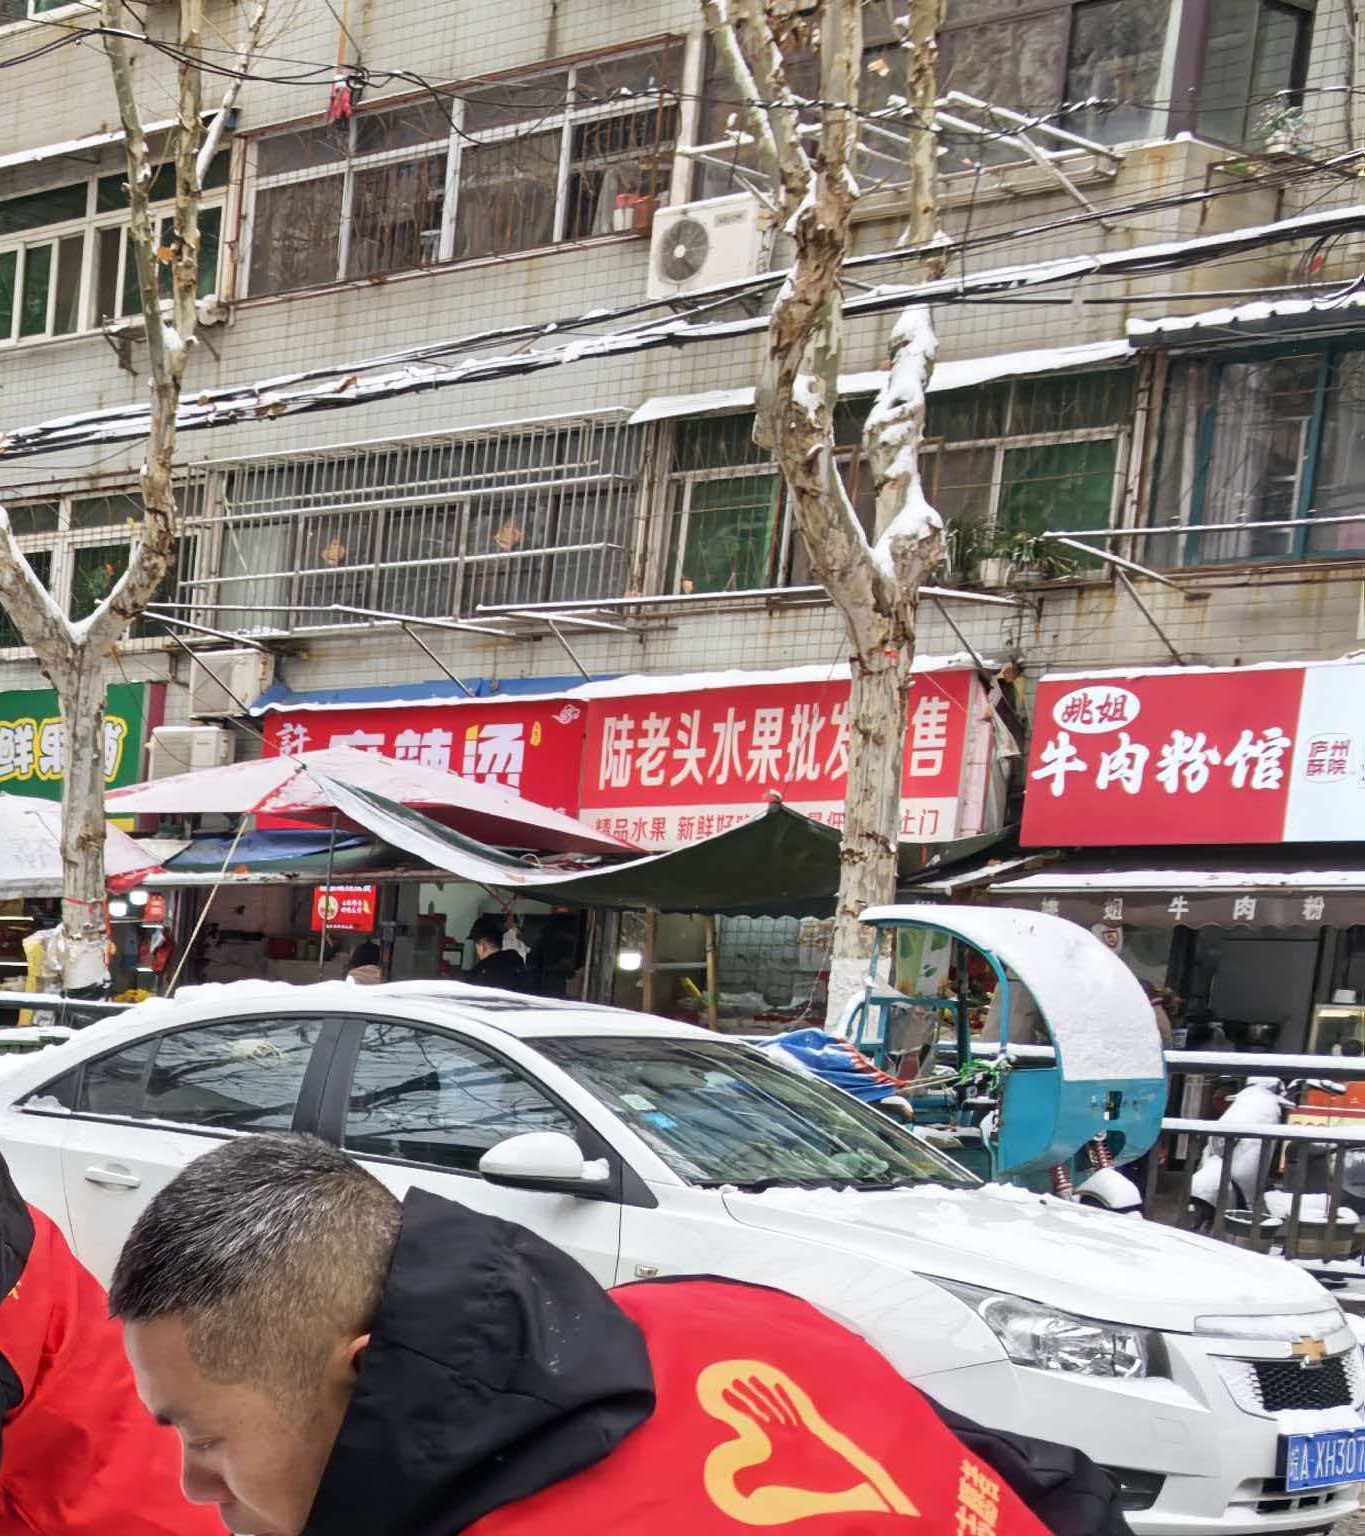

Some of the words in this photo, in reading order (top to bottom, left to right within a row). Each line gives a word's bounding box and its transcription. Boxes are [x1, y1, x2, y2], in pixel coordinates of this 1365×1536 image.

[598, 696, 951, 791] 陆老头水果批发售
[1031, 727, 1291, 797] 牛肉粉馆
